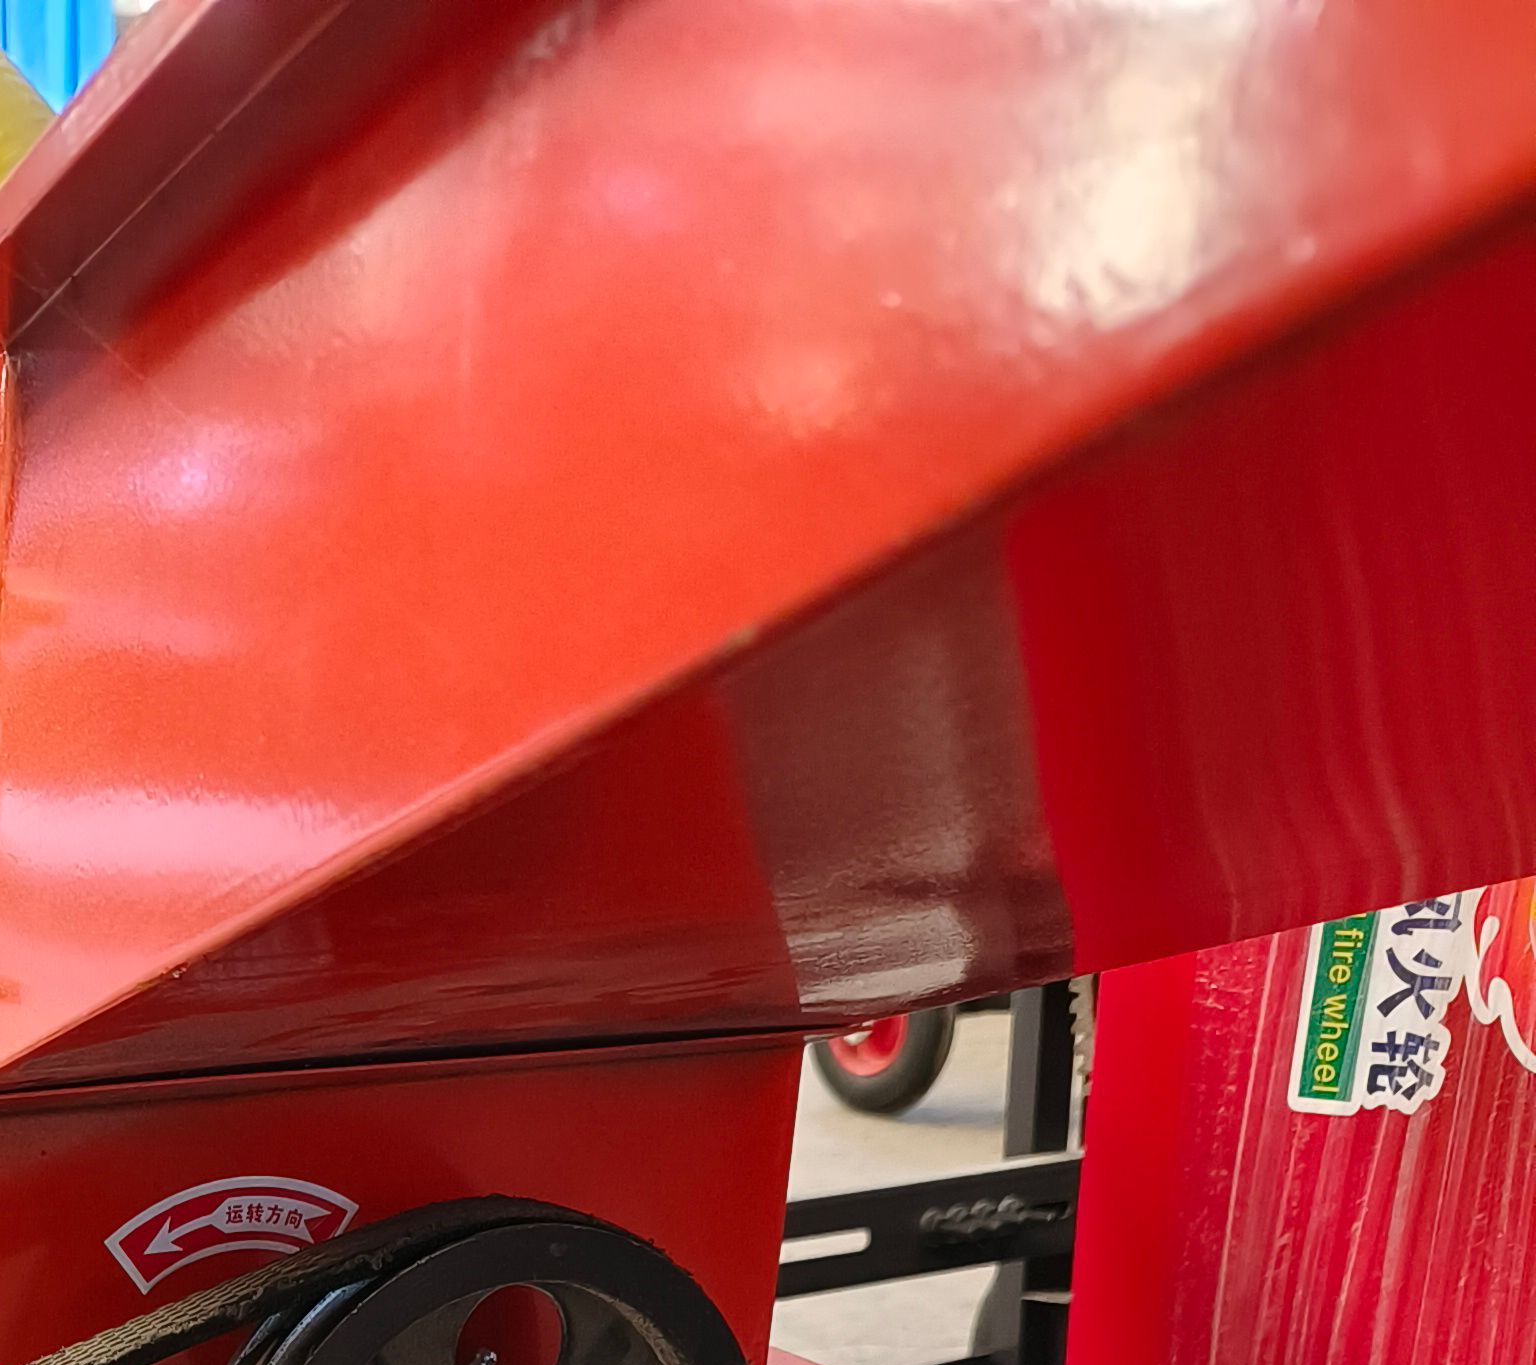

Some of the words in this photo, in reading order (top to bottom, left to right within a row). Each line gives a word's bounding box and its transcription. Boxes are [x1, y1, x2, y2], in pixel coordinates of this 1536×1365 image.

[1328, 928, 1365, 985] fire
[1311, 993, 1349, 1093] wheel
[225, 1203, 303, 1229] 运转方向
